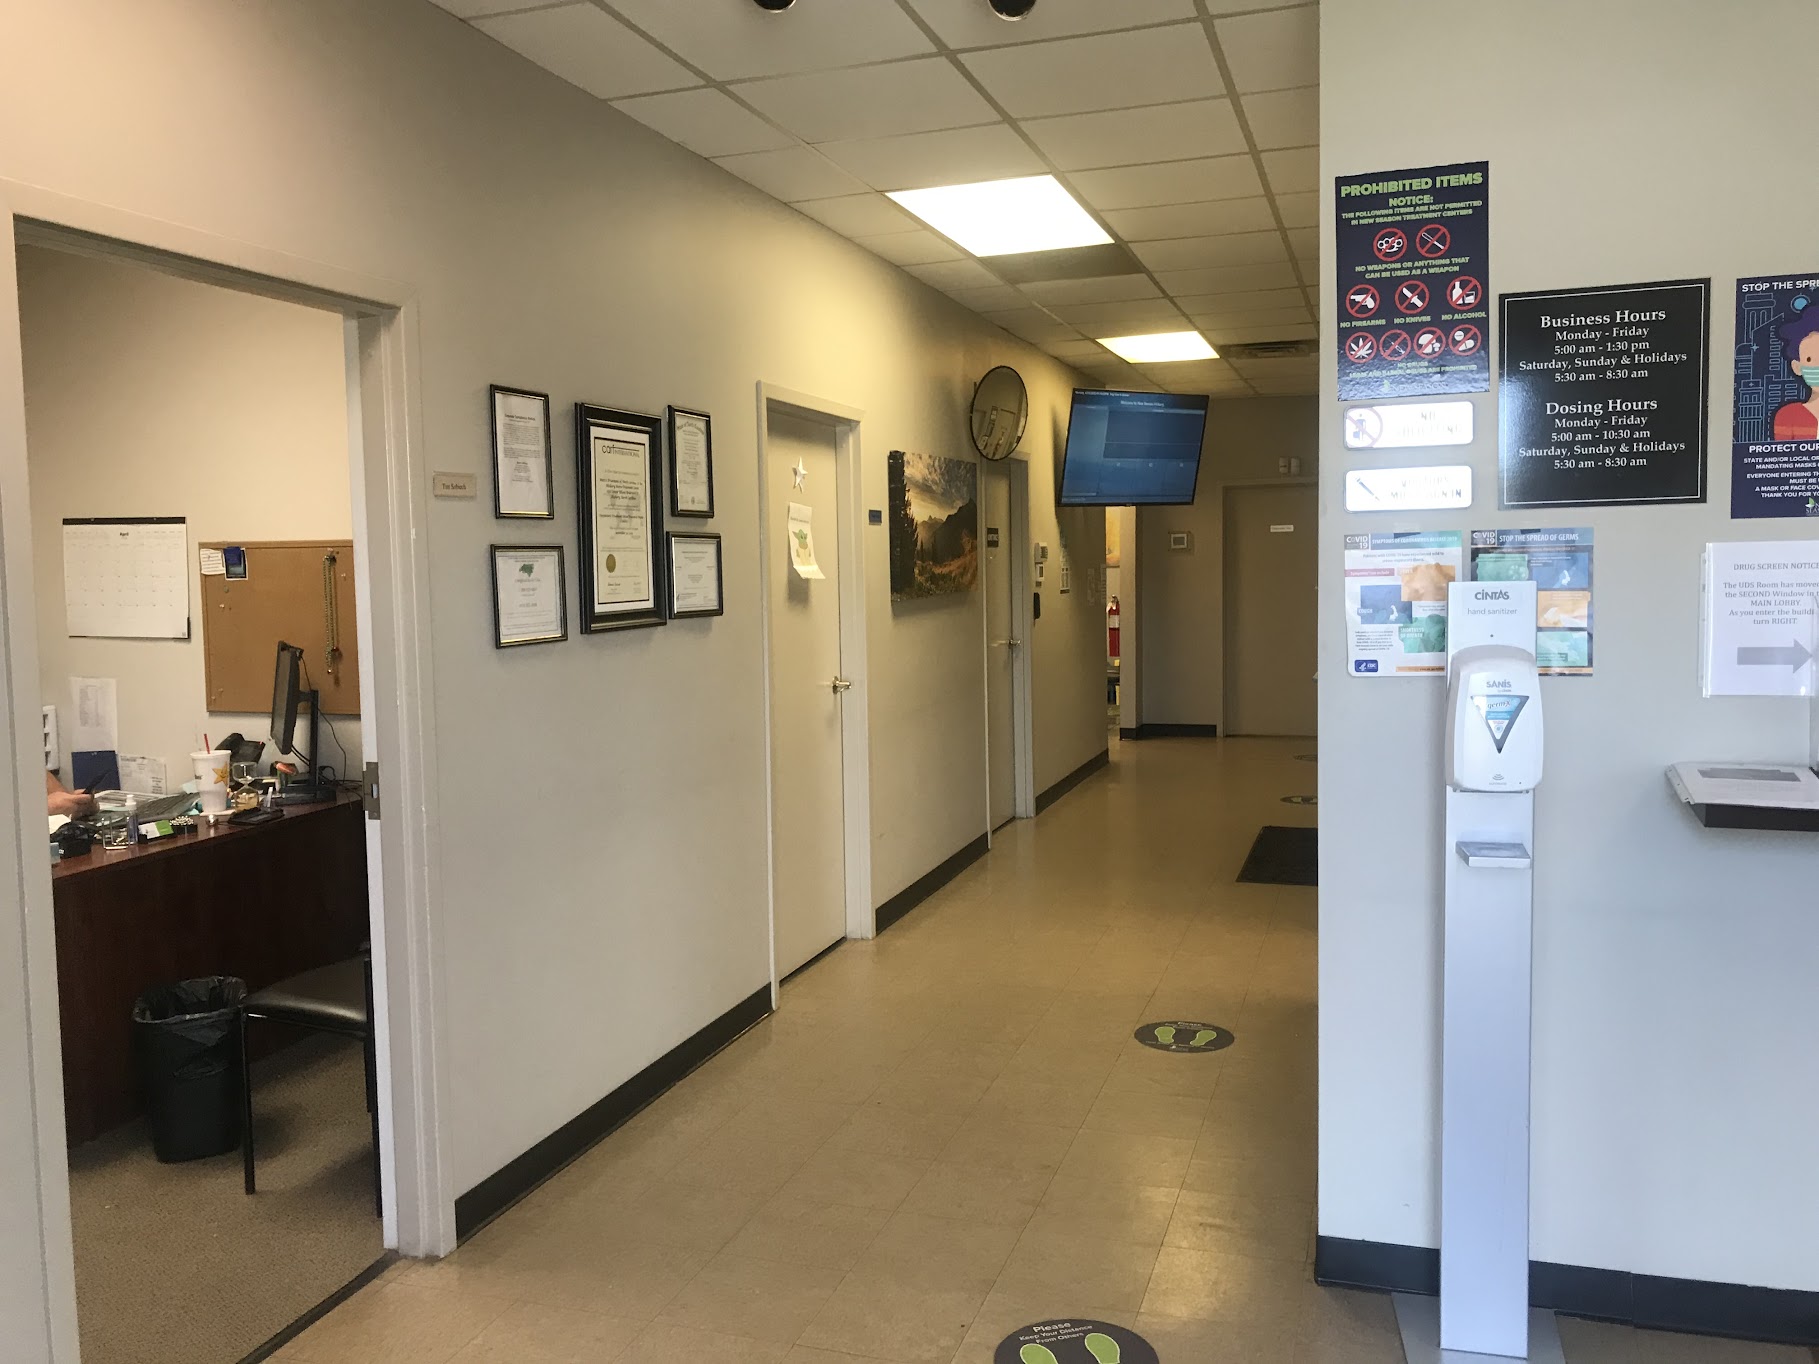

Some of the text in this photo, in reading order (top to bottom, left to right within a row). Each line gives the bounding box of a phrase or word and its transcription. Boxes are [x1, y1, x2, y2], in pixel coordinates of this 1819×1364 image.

[1341, 172, 1482, 197] PROHIBITED ITEMS
[1389, 195, 1434, 206] NOTICE:
[1356, 209, 1393, 218] FOLLOWING
[1444, 200, 1482, 209] PERMITTED
[1376, 216, 1402, 224] SEASON
[1403, 212, 1442, 220] TREATMENT
[1442, 209, 1472, 217] CENTERS
[1367, 263, 1401, 271] WEAPONS
[1414, 258, 1450, 267] ANYTHING
[1429, 266, 1460, 274] WEAPON
[1742, 282, 1793, 292] STOP THE
[1352, 319, 1386, 327] FIREARMS
[1540, 310, 1666, 328] Business Hours
[1556, 330, 1602, 342] Monday
[1612, 326, 1650, 338] Friday
[1554, 345, 1576, 354] 5:00
[1606, 342, 1628, 352] 1:30
[1631, 342, 1650, 352] pm
[1519, 353, 1687, 372] Saturday, Sunday & Holidays
[1554, 373, 1576, 382] 5:30
[1579, 373, 1596, 381] am
[1606, 370, 1628, 380] 8:30
[1546, 398, 1658, 416] Dosing Hours
[1554, 418, 1600, 429] Monday
[1611, 415, 1648, 426] Friday
[1551, 432, 1572, 442] 5:00
[1602, 430, 1630, 440] 10:30
[1519, 441, 1686, 458] Saturday, Sunday & Holidays
[1749, 444, 1797, 453] PROTECT
[1554, 460, 1575, 469] 5:30
[1605, 457, 1627, 467] 8:30
[1033, 1322, 1070, 1332] Please
[1060, 1325, 1093, 1334] Distance
